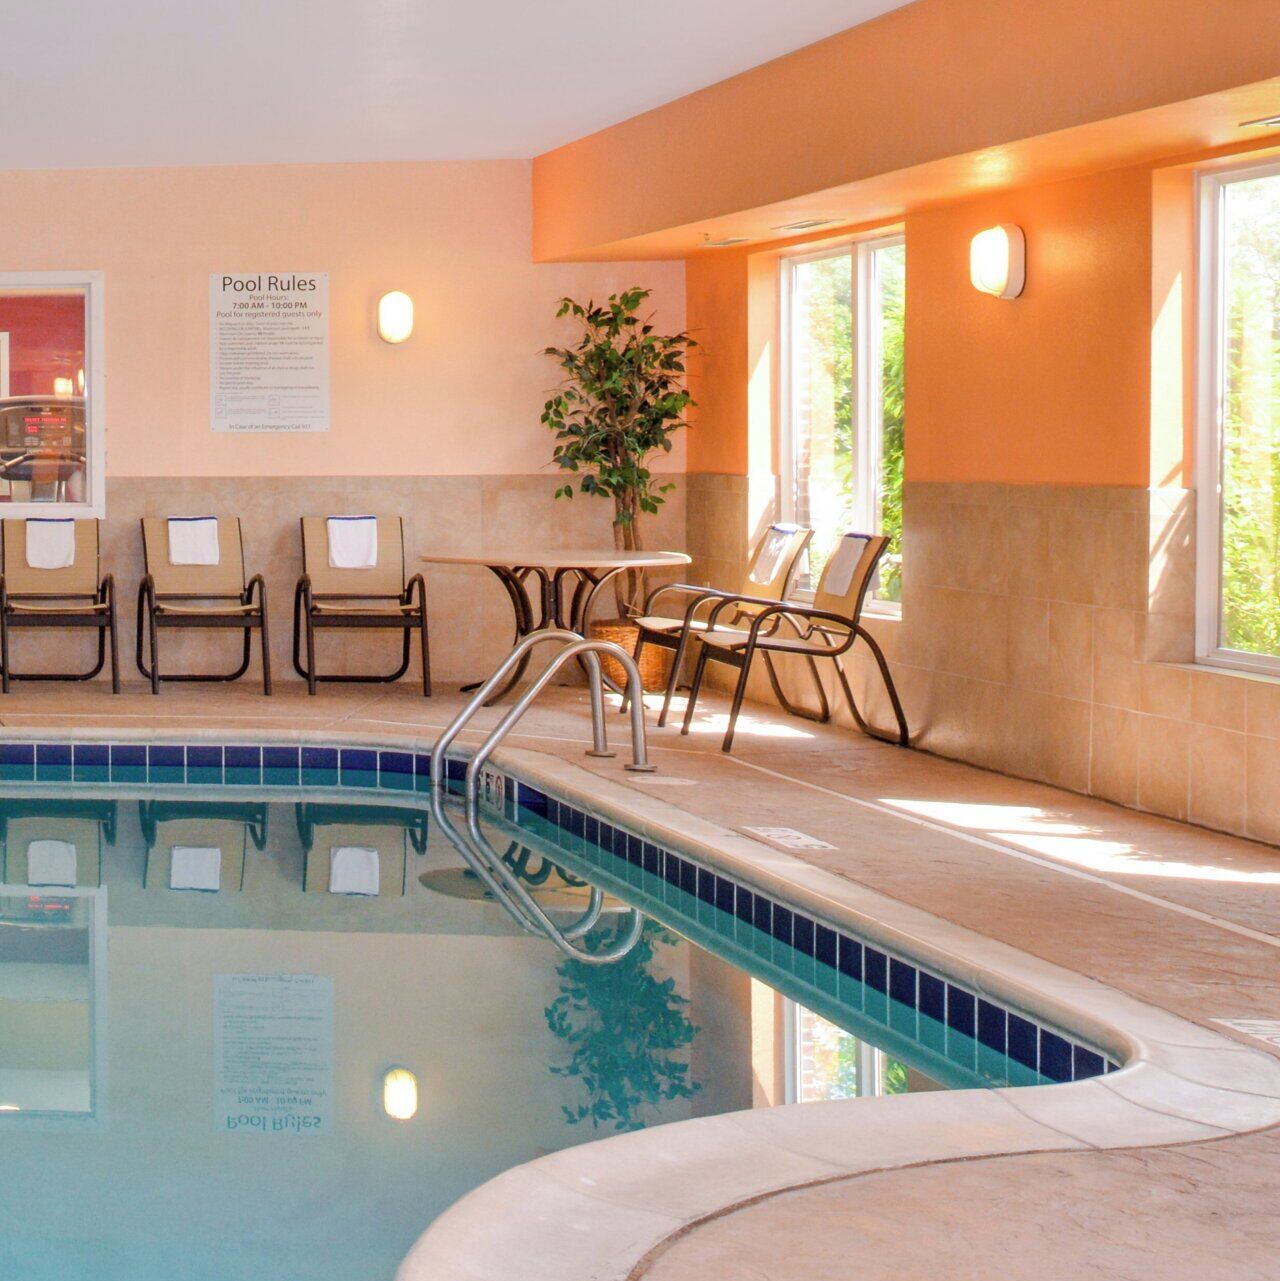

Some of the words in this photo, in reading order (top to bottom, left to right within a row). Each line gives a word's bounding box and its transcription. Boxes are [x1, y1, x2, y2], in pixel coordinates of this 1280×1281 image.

[222, 275, 261, 292] Pool
[268, 275, 316, 291] Rules
[294, 301, 308, 309] PM
[245, 311, 280, 319] registered
[282, 311, 306, 319] guests
[306, 310, 322, 318] only
